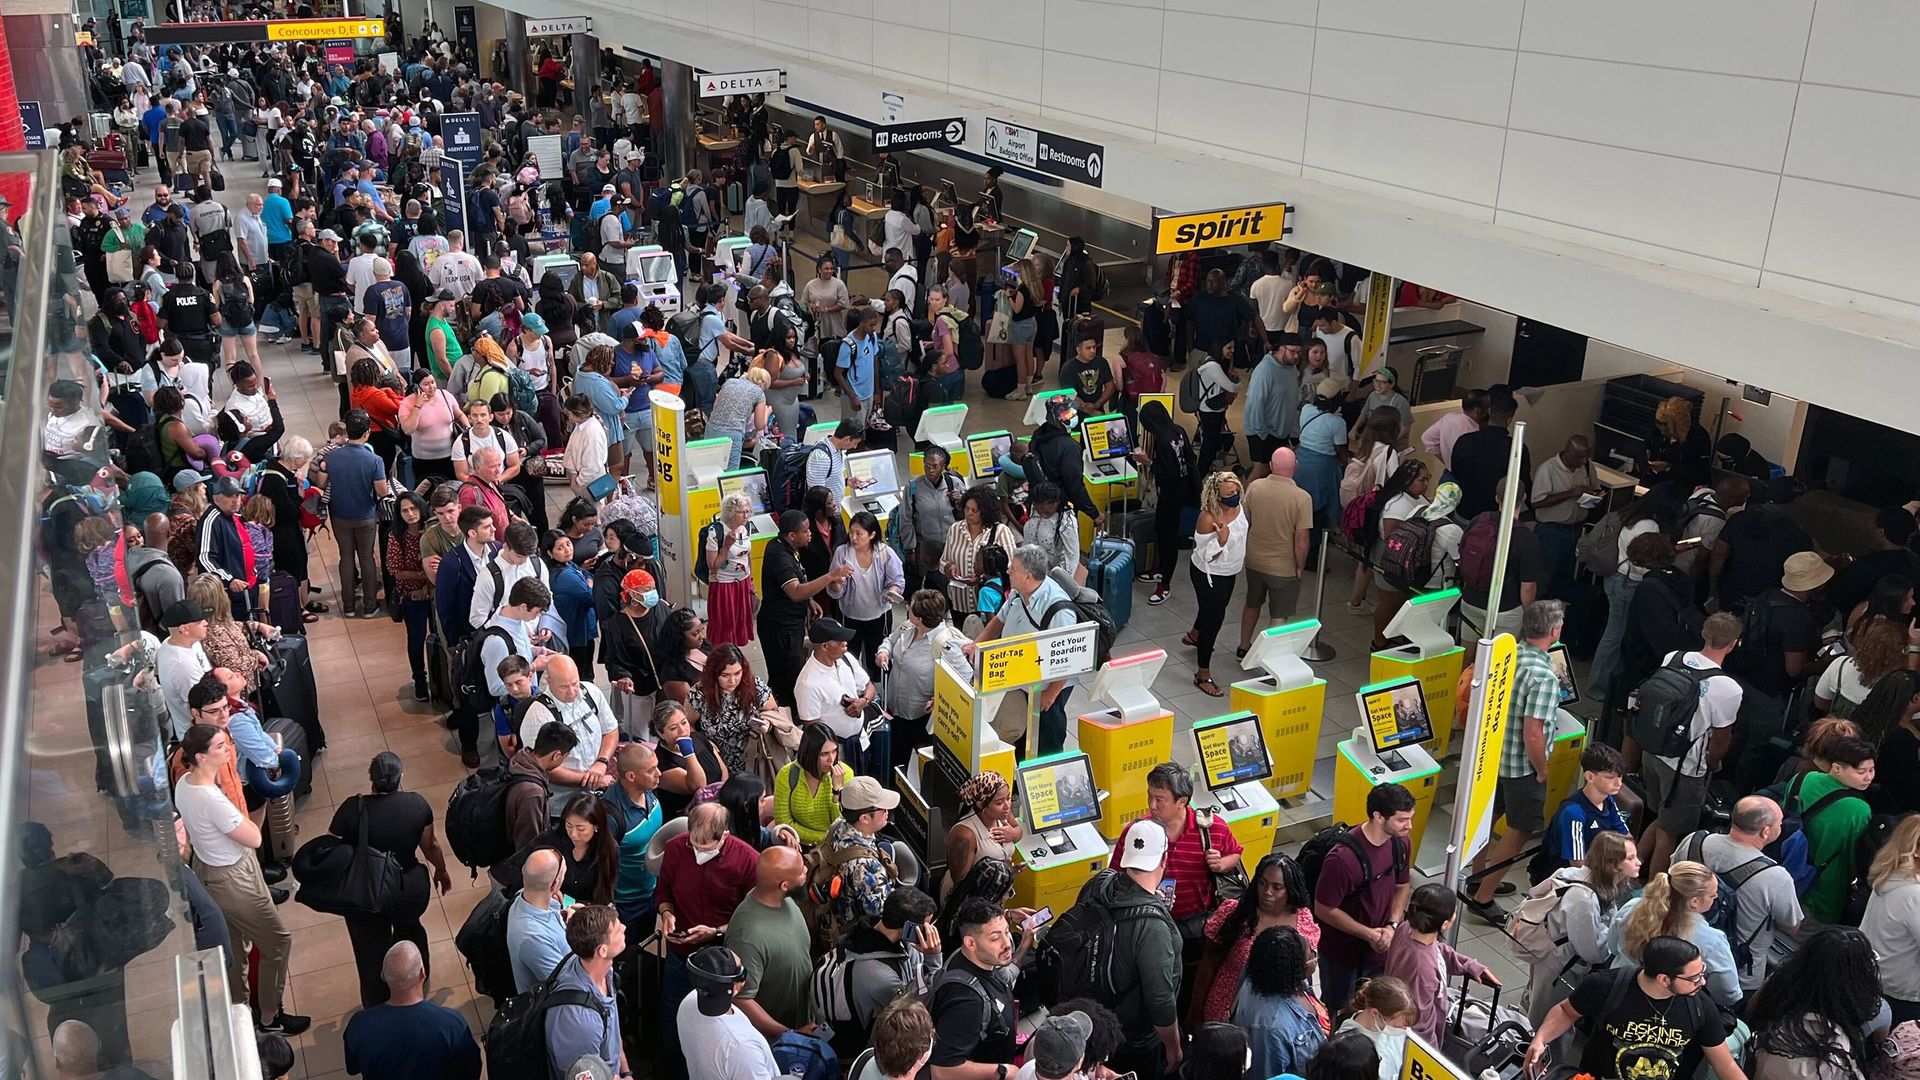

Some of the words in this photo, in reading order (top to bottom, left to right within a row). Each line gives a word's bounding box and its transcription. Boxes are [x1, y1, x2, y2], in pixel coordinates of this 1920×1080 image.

[278, 26, 336, 37] Concourses
[338, 25, 355, 36] D,E
[541, 22, 574, 32] DELTA
[720, 78, 762, 90] DELTA
[891, 130, 942, 144] Restrooms
[1008, 138, 1026, 150] Airport
[1000, 146, 1019, 160] Badging
[1019, 152, 1034, 164] Office
[1050, 148, 1086, 168] Restrooms
[1175, 211, 1263, 248] spirit
[176, 296, 198, 306] POLICE
[989, 660, 1008, 670] Your
[1050, 644, 1087, 657] Boarding
[990, 648, 1024, 661] Self-Tag
[1051, 640, 1065, 648] Get
[1067, 636, 1086, 645] Your
[989, 670, 1005, 678] Bag
[1050, 656, 1068, 666] Pass
[1499, 652, 1512, 690] Bag
[938, 692, 950, 710] Have
[950, 706, 960, 720] you
[1492, 690, 1506, 734] Drop
[938, 705, 948, 720] paid
[956, 724, 967, 740] your
[1372, 712, 1392, 722] Space
[1485, 714, 1492, 727] de
[938, 717, 960, 744] carry-on?
[1205, 748, 1227, 759] Space
[1477, 730, 1488, 782] equipaje
[1030, 790, 1053, 800] Space
[1627, 1021, 1682, 1040] ASKING
